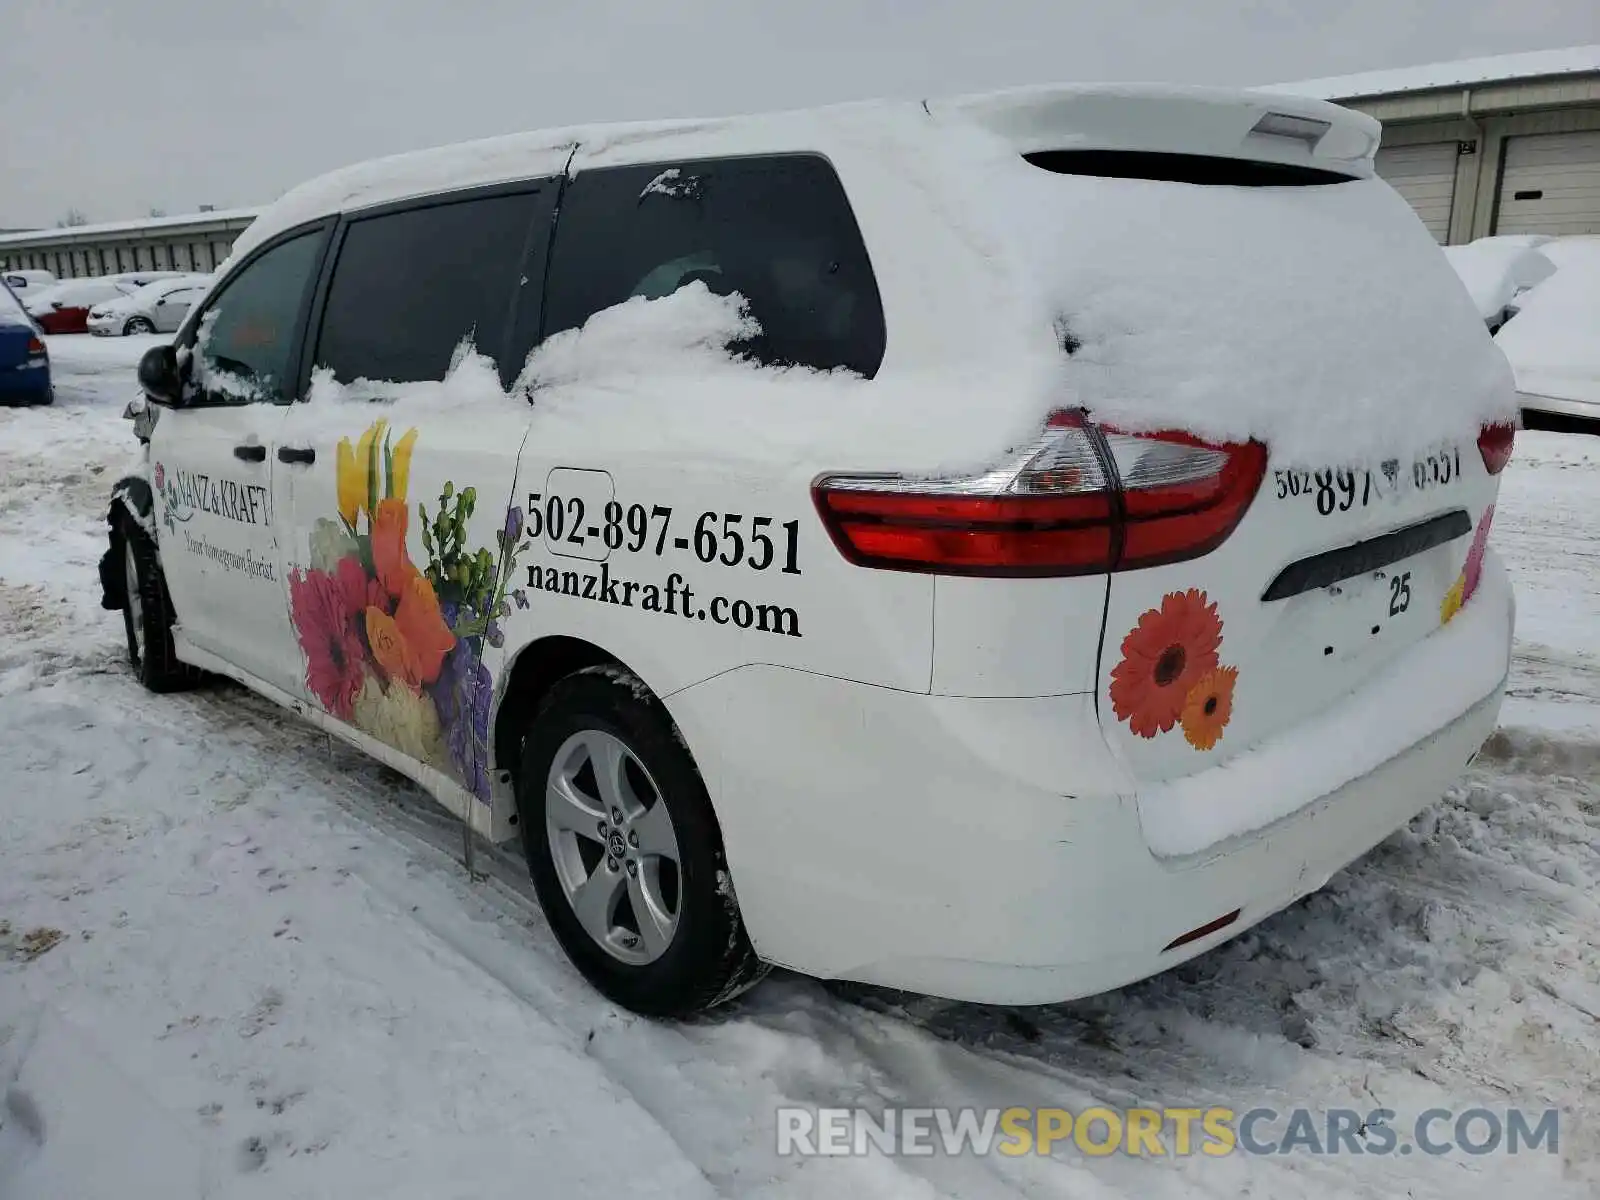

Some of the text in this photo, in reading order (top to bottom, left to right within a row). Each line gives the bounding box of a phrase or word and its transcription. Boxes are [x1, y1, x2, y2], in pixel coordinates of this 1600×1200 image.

[1275, 469, 1313, 500] 502
[1315, 464, 1371, 516] 897
[526, 493, 802, 575] 502-897-6551
[526, 562, 803, 638] nanzkraft.com
[1389, 571, 1412, 618] 25
